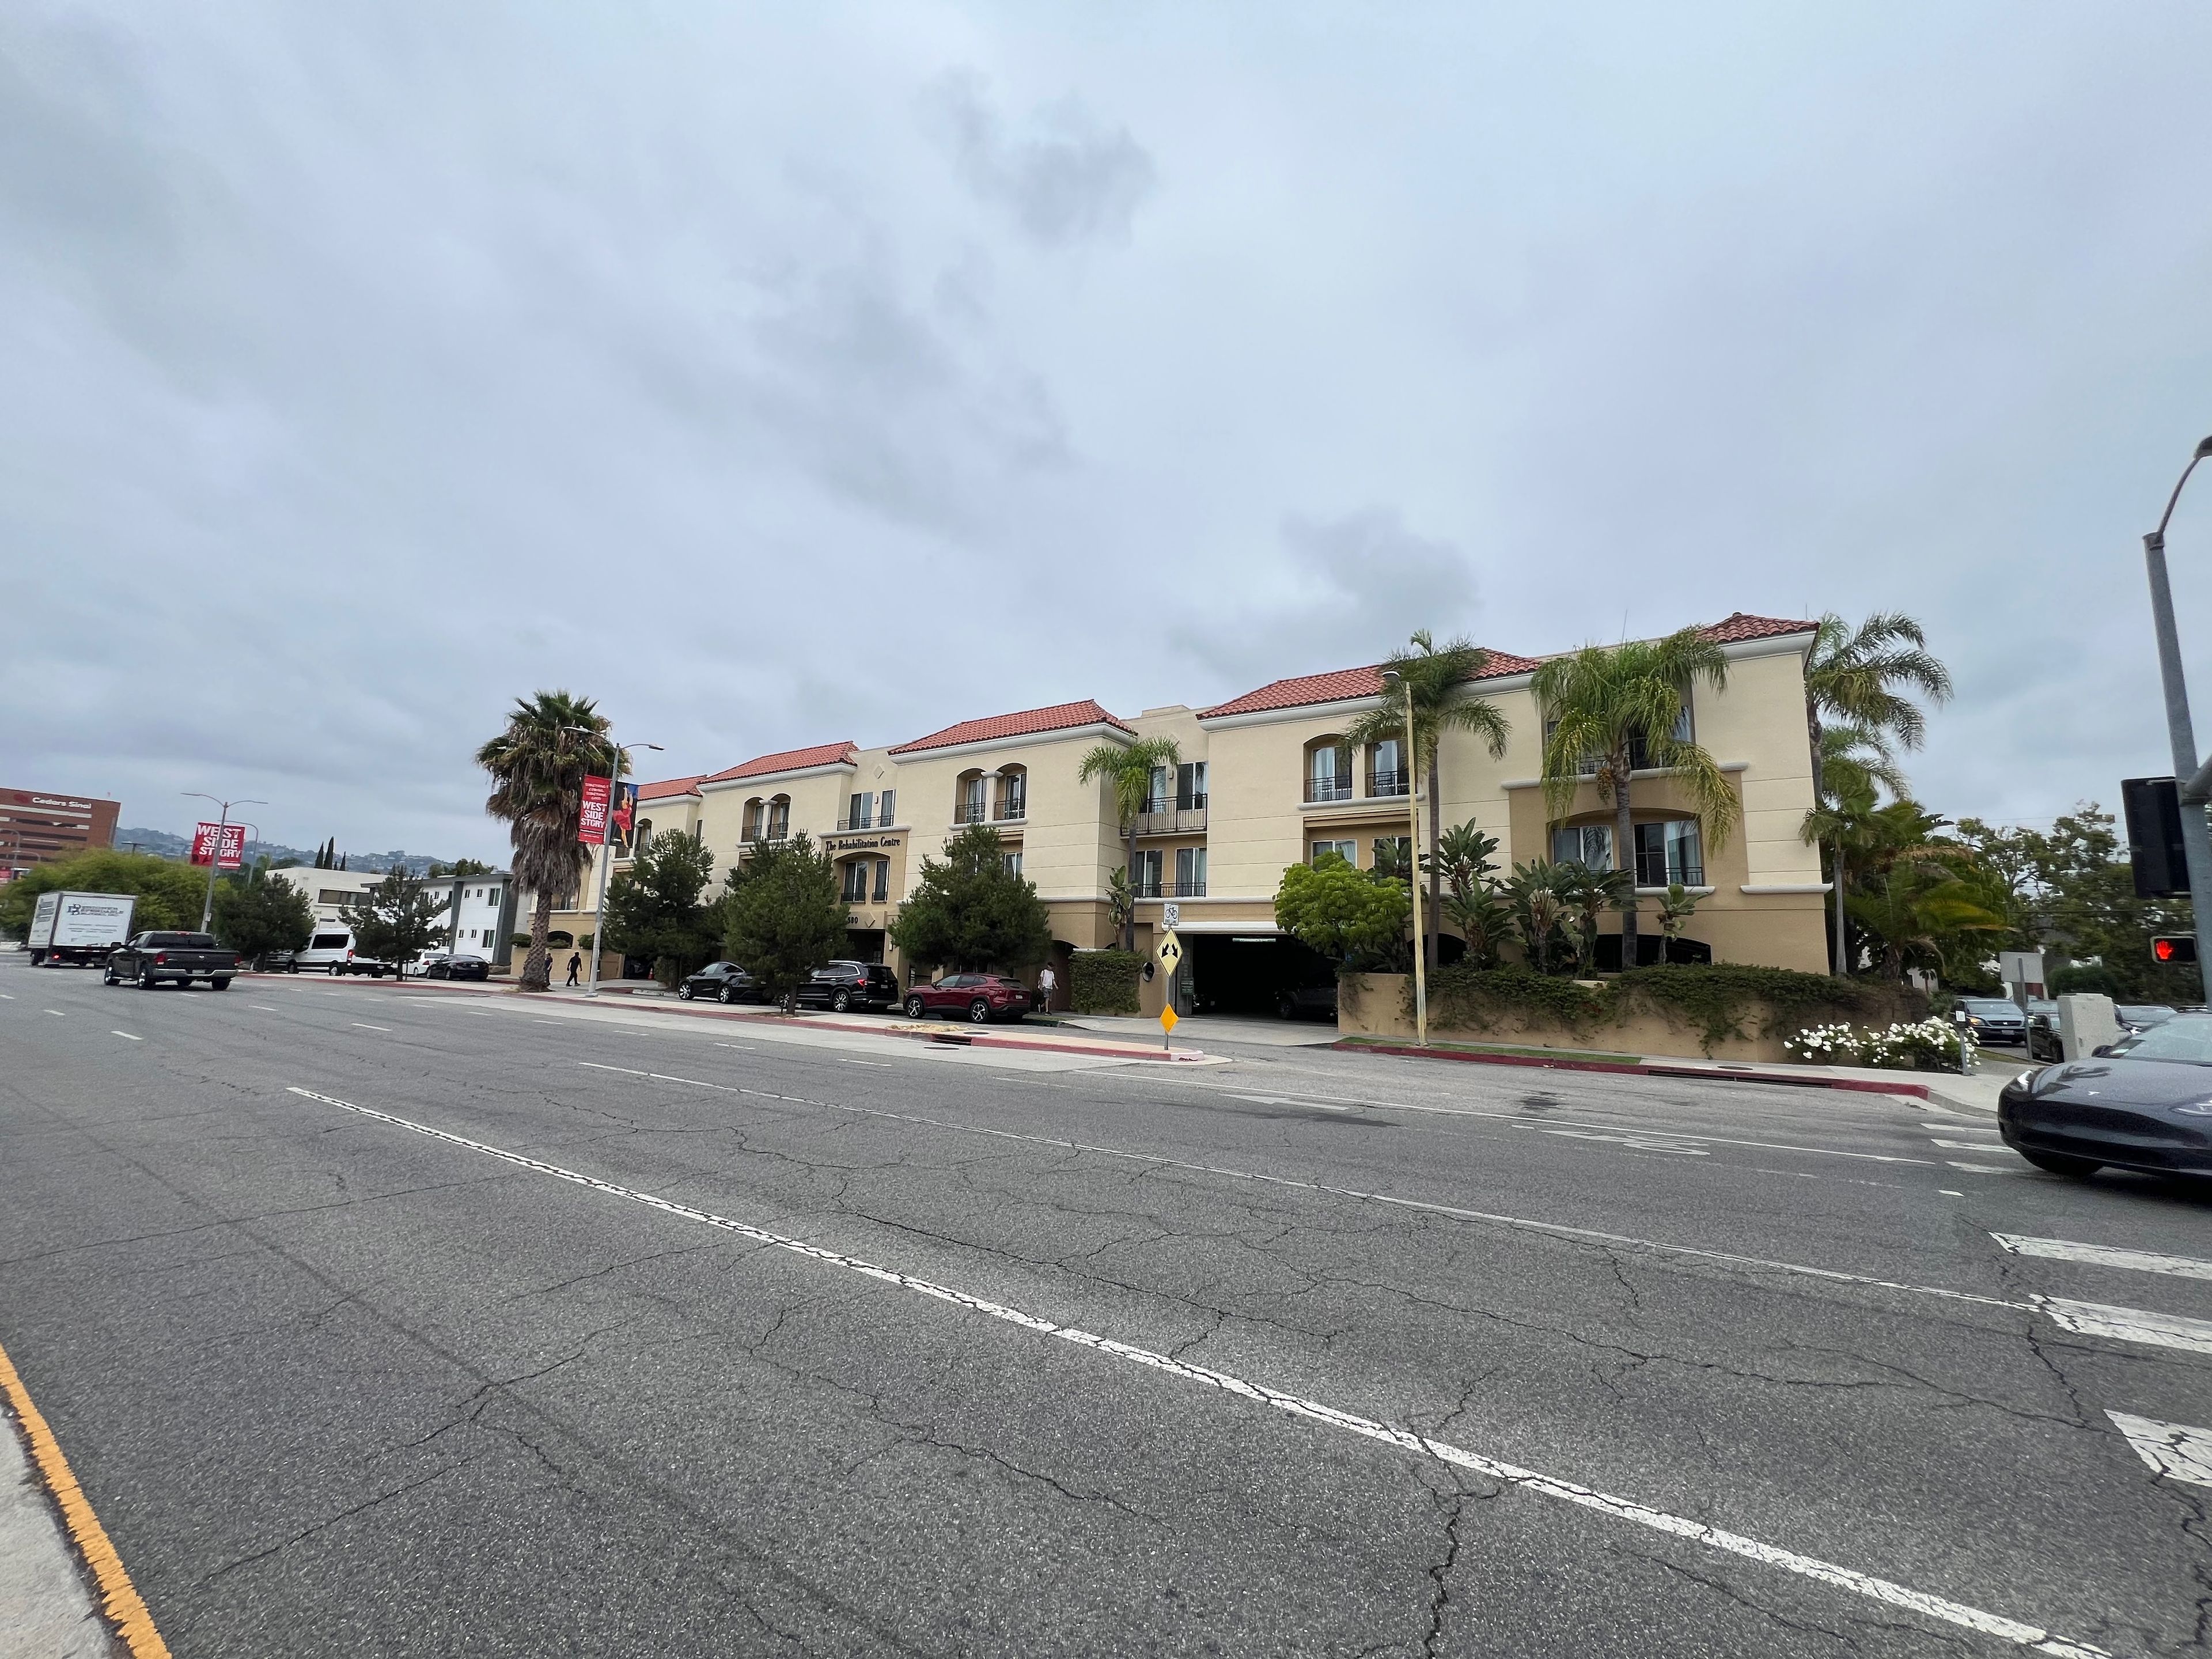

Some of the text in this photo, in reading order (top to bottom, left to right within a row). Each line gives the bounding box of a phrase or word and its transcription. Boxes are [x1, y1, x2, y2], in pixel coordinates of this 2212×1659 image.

[32, 797, 92, 809] Cedars Sinai
[582, 800, 607, 812] WEST
[584, 809, 604, 820] SIDE
[581, 818, 605, 828] STORY
[198, 824, 241, 839] WEST
[202, 836, 239, 849] SIDE
[825, 836, 900, 851] The Rehabilitation Centre
